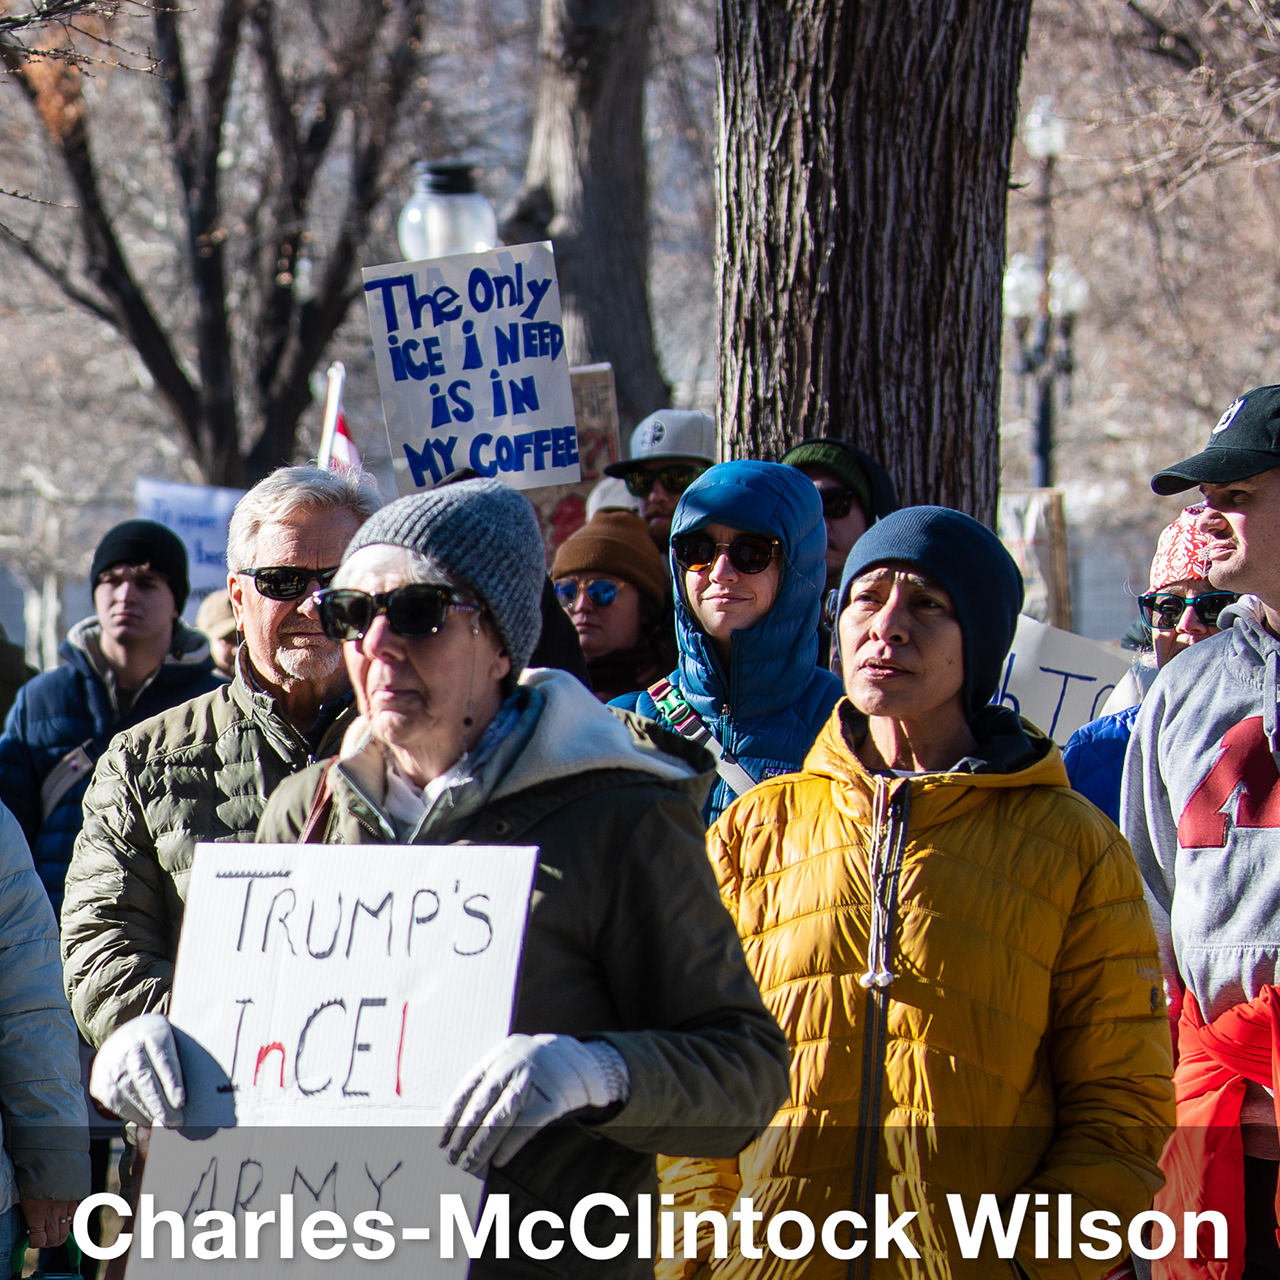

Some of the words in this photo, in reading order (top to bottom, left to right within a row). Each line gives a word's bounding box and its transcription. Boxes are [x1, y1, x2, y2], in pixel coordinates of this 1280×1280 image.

[364, 274, 463, 333] The
[468, 262, 552, 320] Only
[494, 321, 565, 362] NEED
[402, 435, 459, 488] MY
[469, 426, 580, 478] COFFEE
[216, 869, 493, 959] TRUMP'S
